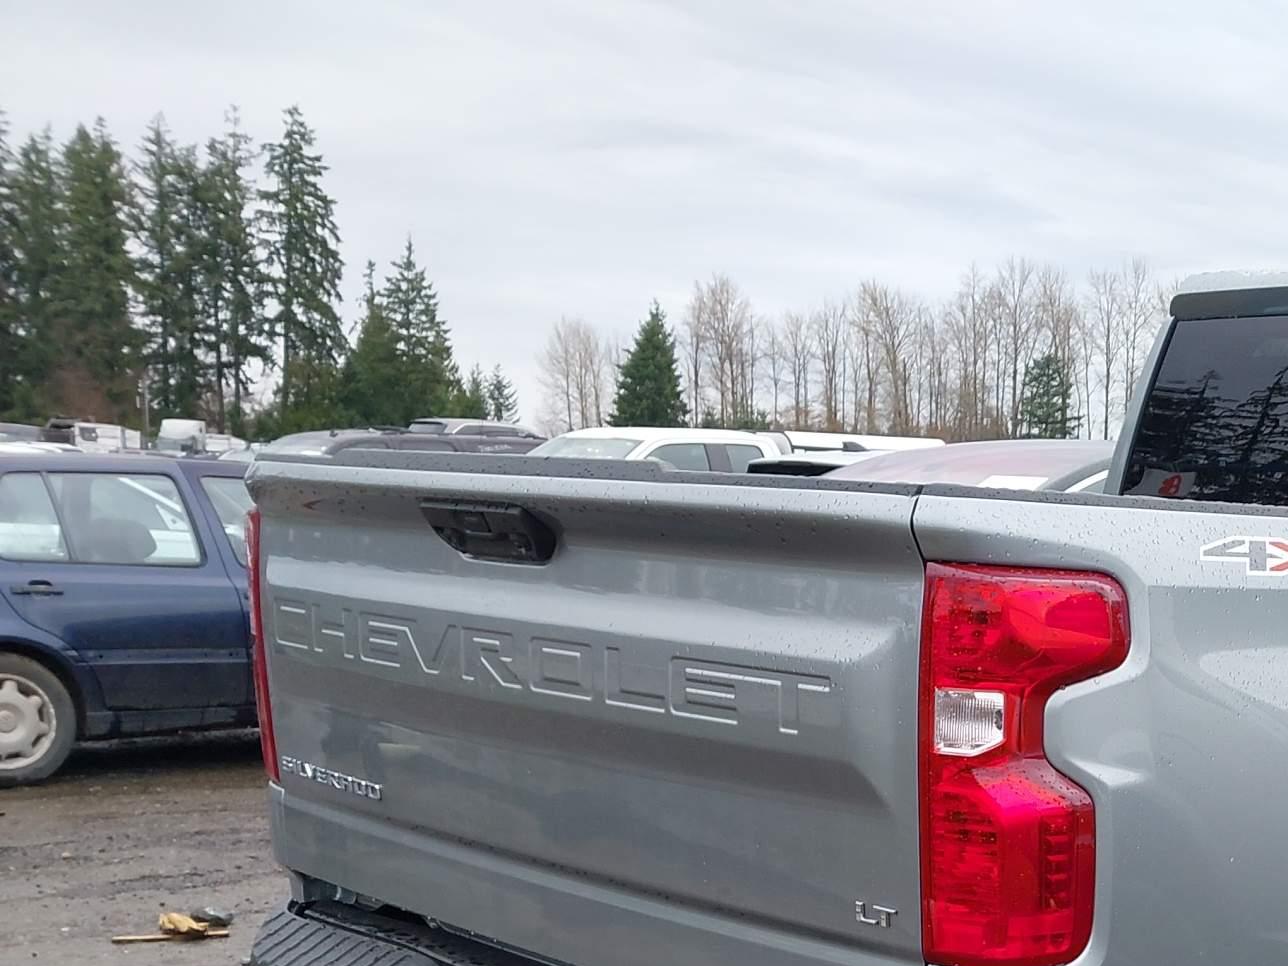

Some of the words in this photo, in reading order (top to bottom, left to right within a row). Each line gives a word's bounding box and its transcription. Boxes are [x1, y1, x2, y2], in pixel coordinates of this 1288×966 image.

[274, 603, 832, 735] CHEVROLET
[281, 755, 383, 800] SILVERADO
[855, 900, 898, 928] LT
